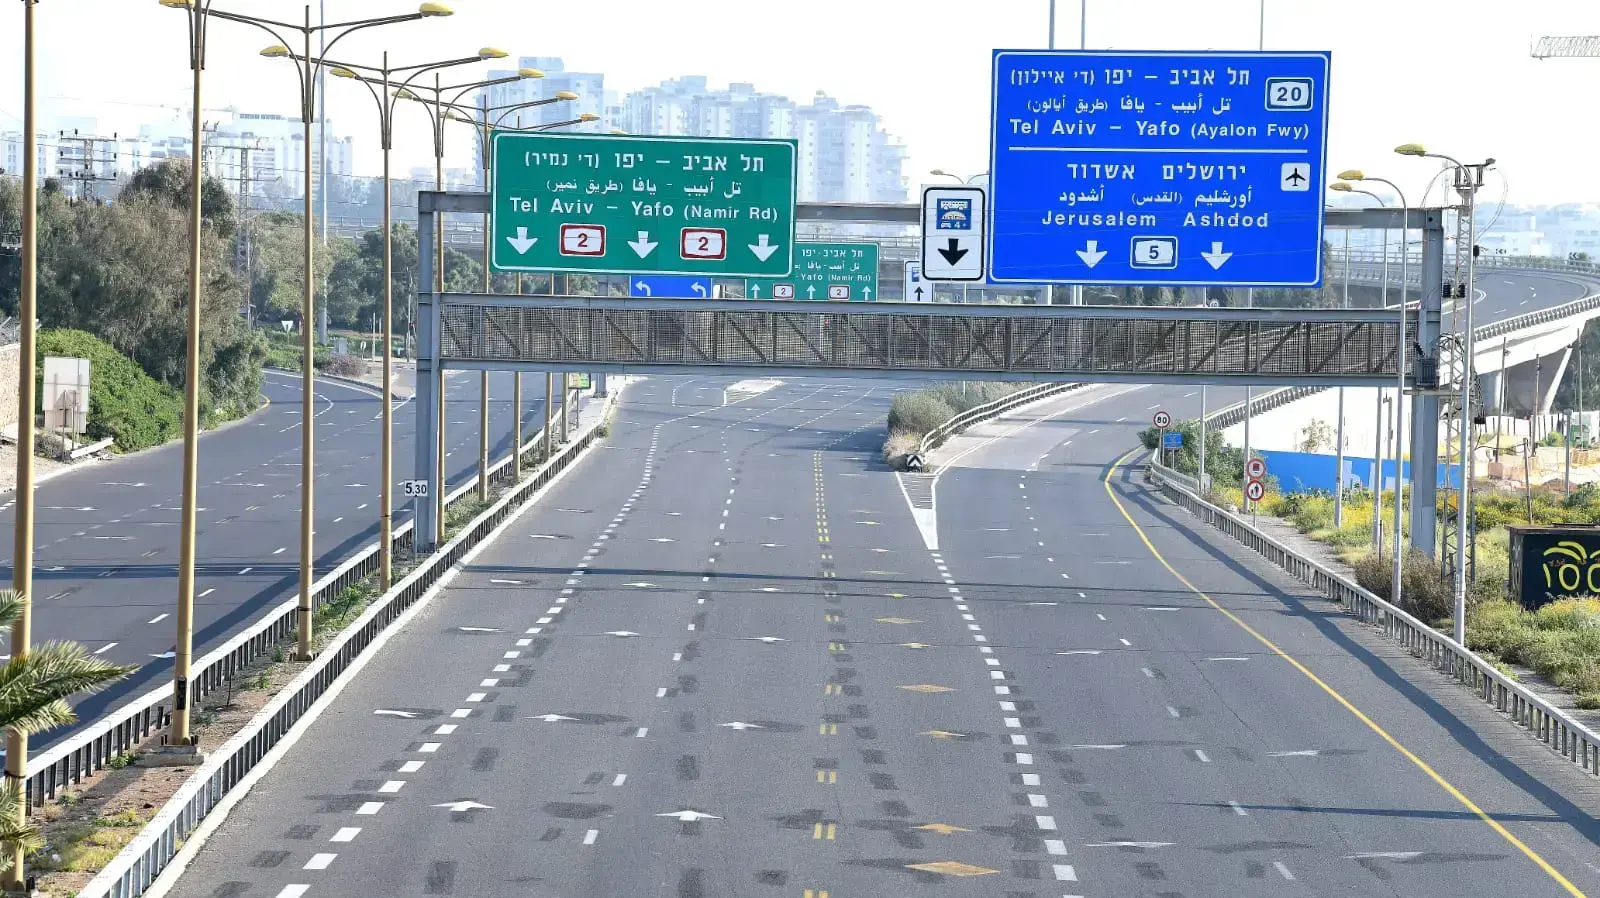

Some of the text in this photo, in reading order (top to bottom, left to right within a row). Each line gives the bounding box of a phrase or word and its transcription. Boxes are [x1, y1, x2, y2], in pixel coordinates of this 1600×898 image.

[1011, 68, 1064, 86] איילון)
[1105, 69, 1132, 85] יפו
[1170, 69, 1215, 85] אביב
[1227, 67, 1250, 85] תל
[1276, 87, 1302, 102] 20
[1075, 98, 1108, 114] (طريق
[1120, 95, 1145, 113] يافا
[1171, 93, 1203, 114] أبيب
[1212, 97, 1232, 115] تل
[1009, 118, 1038, 134] Tel
[1051, 119, 1097, 135] Aviv
[1135, 120, 1180, 136] Yafo
[1191, 123, 1257, 140] (Ayalon
[1267, 123, 1309, 140] Fwy)
[525, 151, 568, 167] נמיר)
[614, 152, 644, 168] יפו
[682, 155, 727, 171] אביב
[740, 154, 764, 172] תל
[1067, 162, 1246, 180] ירושלים אשדוד
[546, 179, 578, 192] نمير)
[585, 179, 623, 195] (طريق
[632, 177, 657, 195] يافا
[683, 176, 715, 197] أبيب
[723, 181, 742, 199] تل
[1059, 184, 1252, 209] أورشليم (القدس) أشدود
[509, 197, 538, 213] Tel
[550, 198, 594, 214] Aviv
[631, 201, 674, 217] Yafo
[684, 204, 740, 220] (Namir
[749, 206, 778, 222] Rd)
[1042, 210, 1268, 228] Jerusalem Ashdod
[577, 232, 588, 248] 2
[698, 235, 709, 251] 2
[851, 249, 863, 257] תל
[1148, 244, 1160, 260] 5
[801, 273, 823, 281] Yafo
[829, 274, 854, 282] (Namir
[781, 287, 787, 295] 2
[836, 288, 842, 296] 2
[1157, 416, 1168, 424] 80
